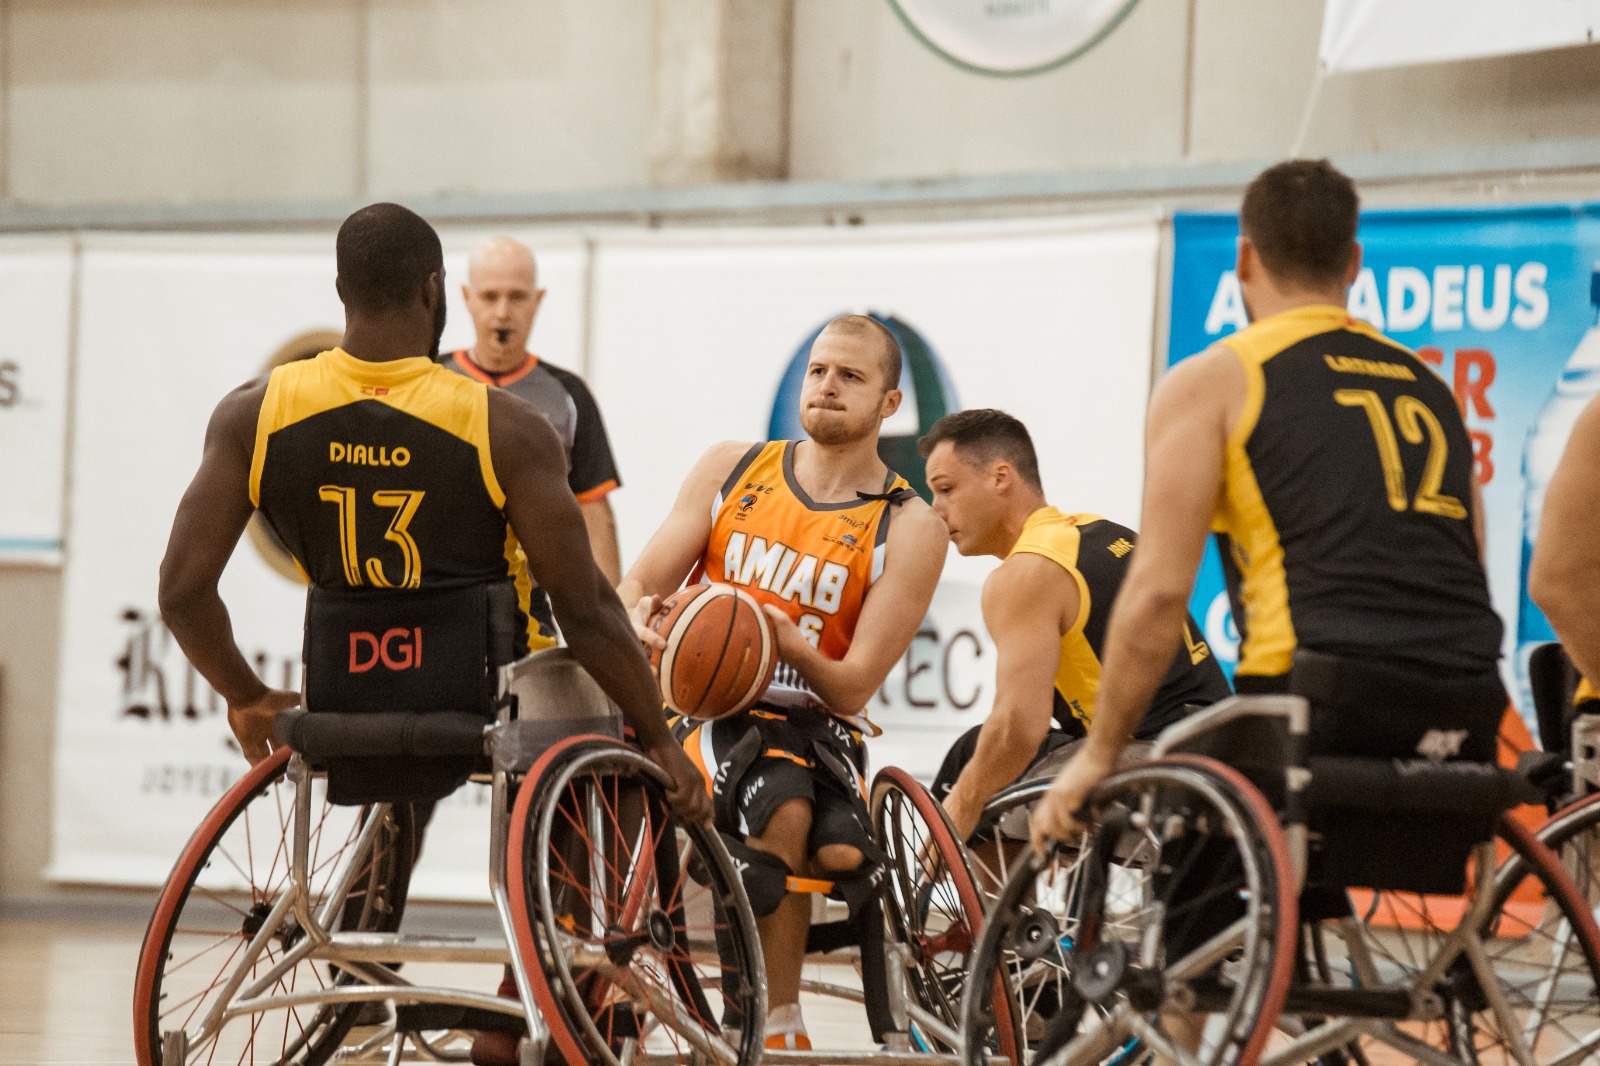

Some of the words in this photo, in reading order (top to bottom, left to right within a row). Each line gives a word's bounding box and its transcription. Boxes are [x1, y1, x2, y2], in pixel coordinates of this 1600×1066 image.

[1204, 261, 1550, 335] AADEUS
[329, 441, 411, 467] DIALLO
[1333, 388, 1468, 520] 12
[318, 484, 426, 590] 13
[723, 530, 850, 616] AMIAB
[349, 626, 422, 673] DGI
